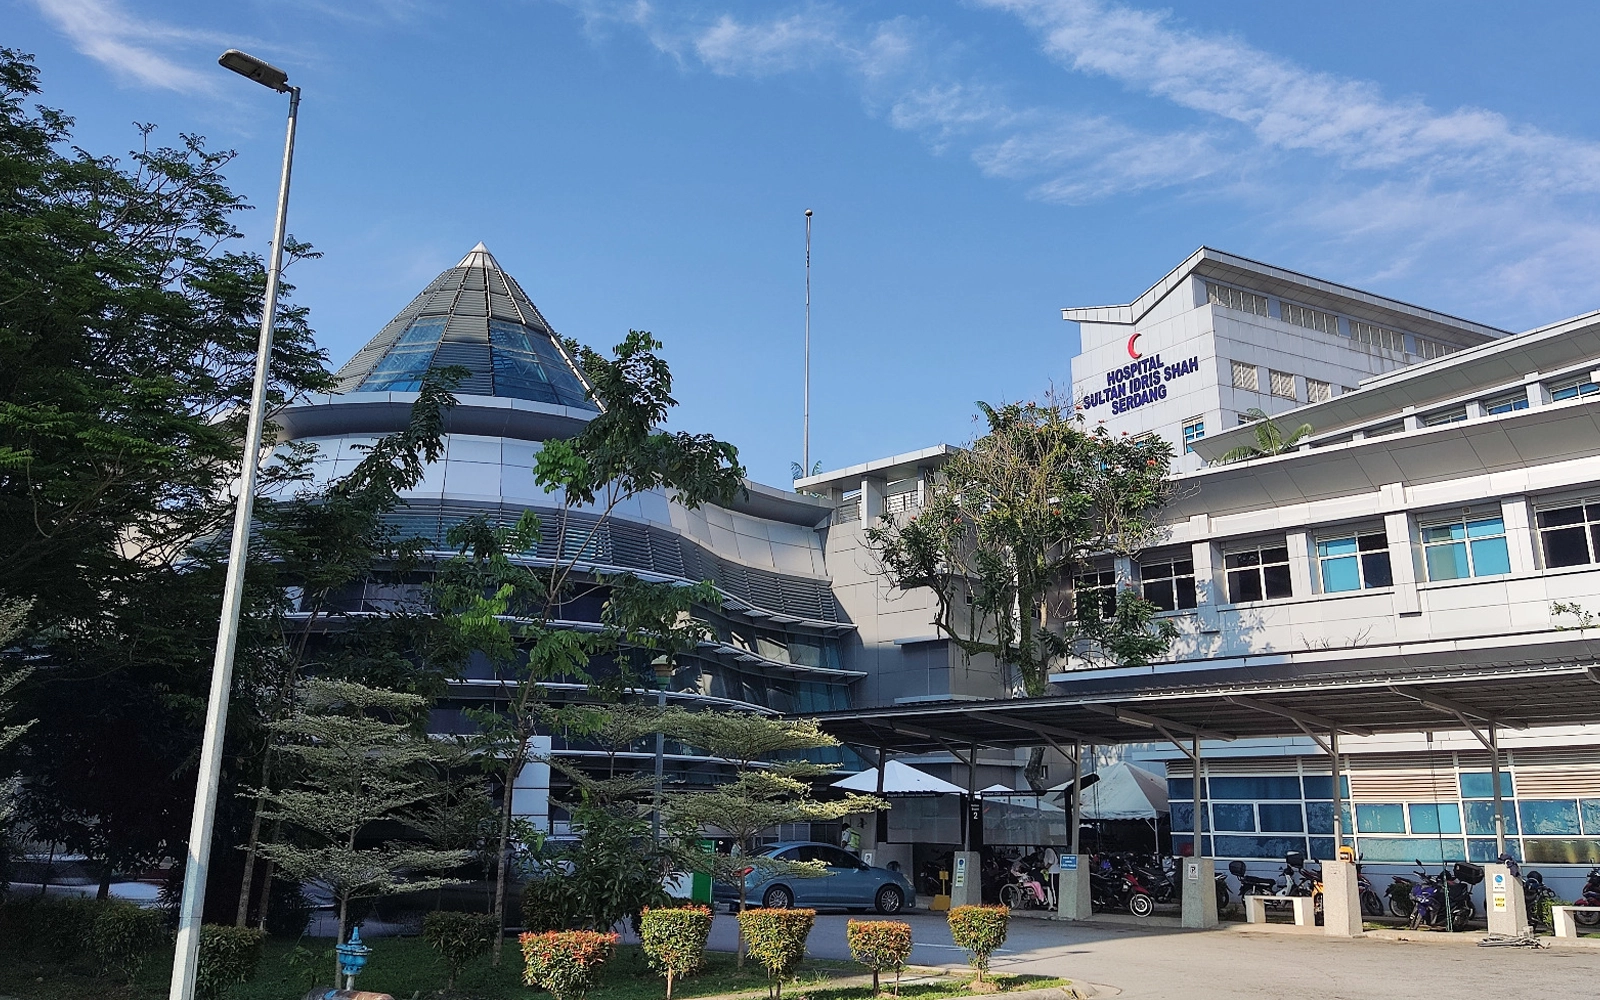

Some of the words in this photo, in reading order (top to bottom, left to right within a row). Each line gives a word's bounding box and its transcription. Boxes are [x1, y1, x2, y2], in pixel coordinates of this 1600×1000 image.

[1083, 382, 1126, 410] SULTAN
[1129, 370, 1161, 394] IDRIS
[1164, 356, 1199, 382] SHAH
[1107, 354, 1164, 386] HOSPITAL
[1111, 384, 1167, 415] SERDANG
[973, 811, 979, 820] 2
